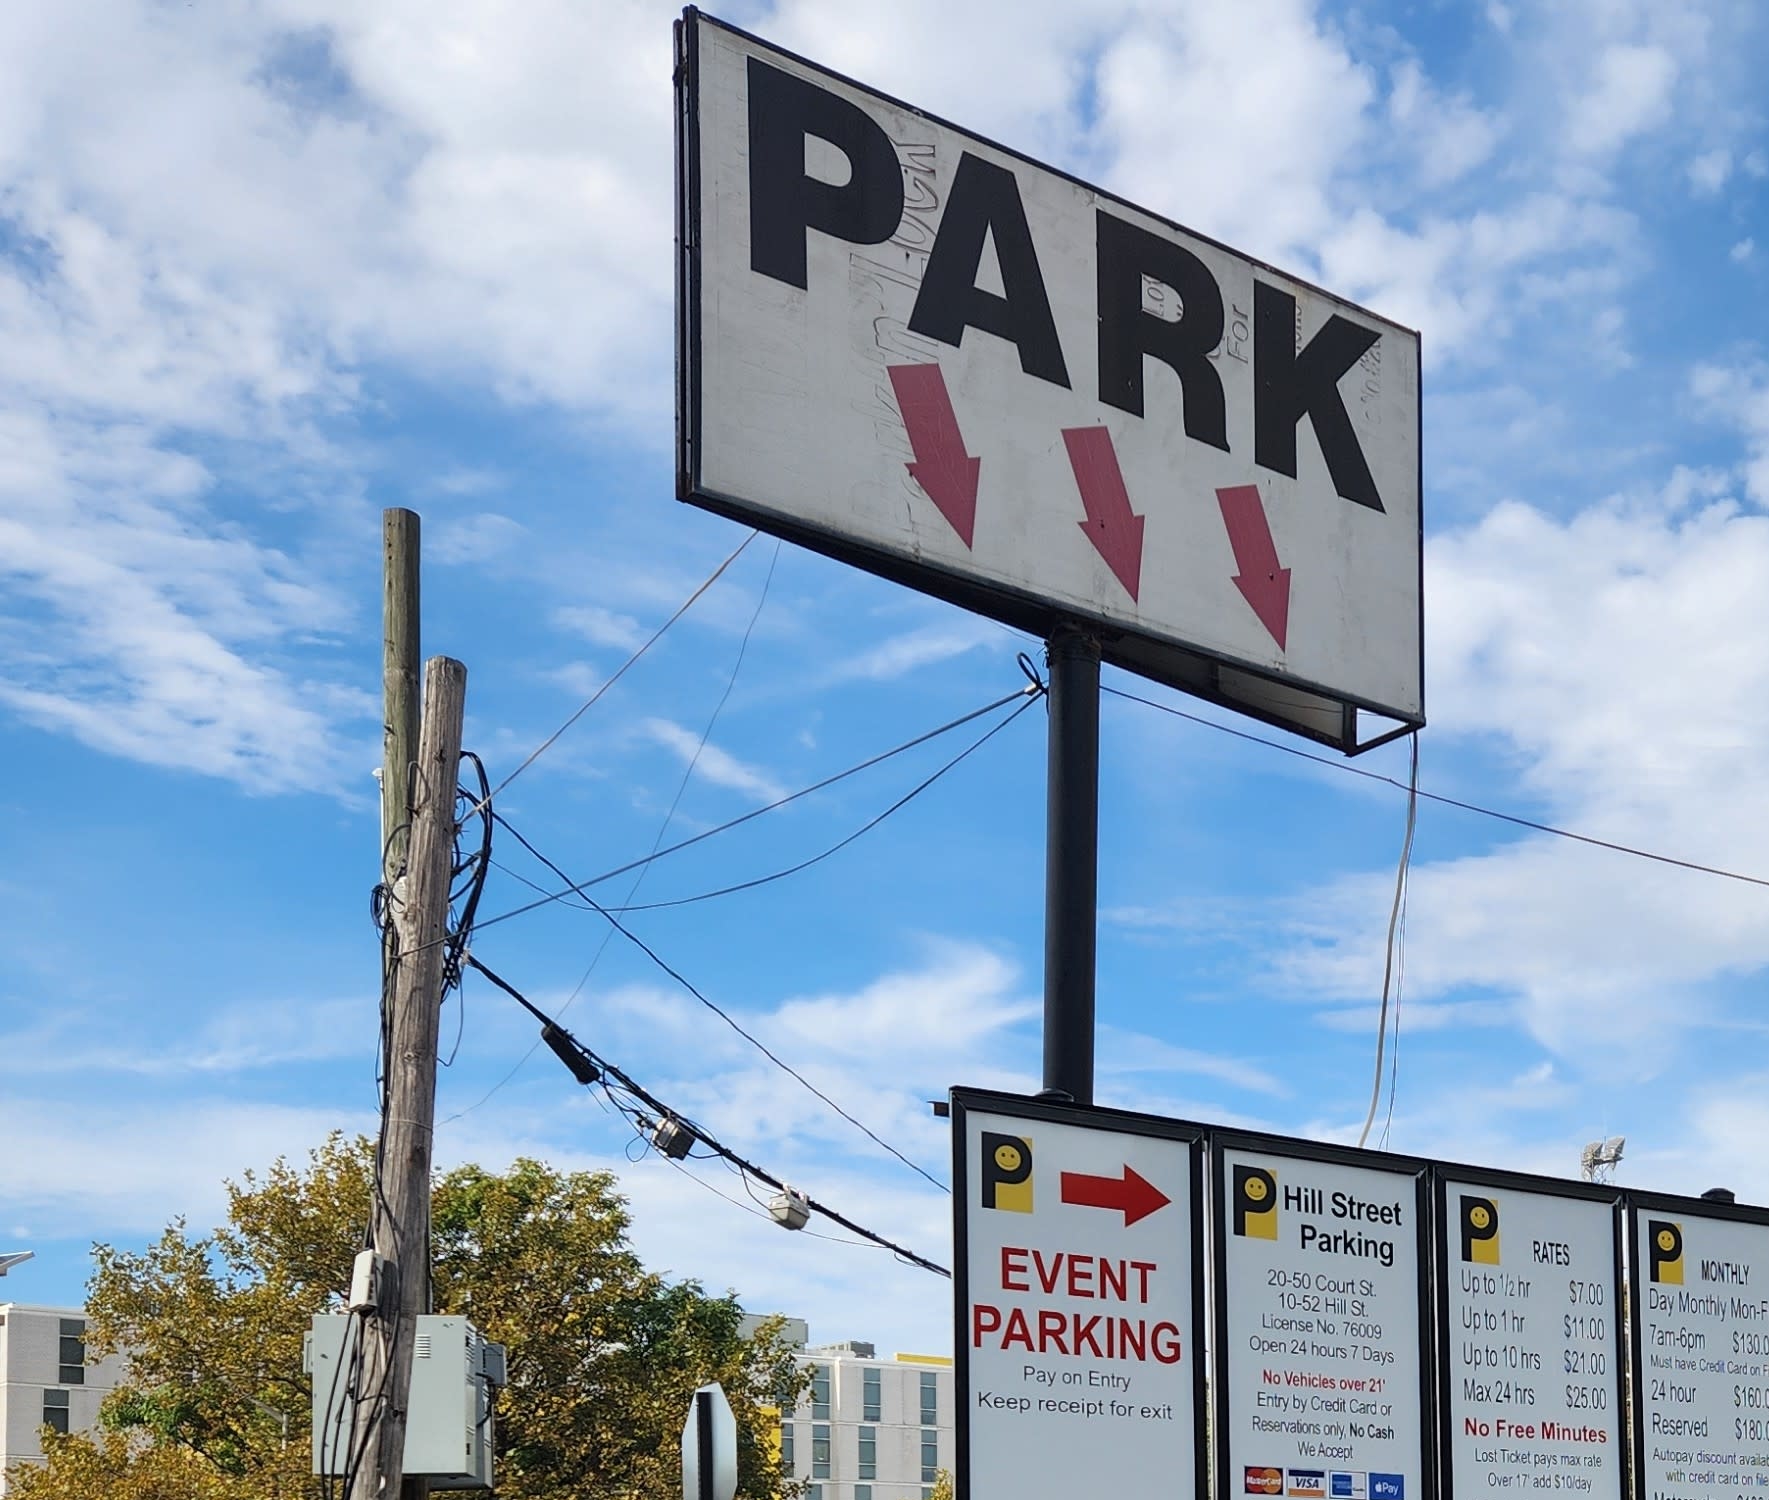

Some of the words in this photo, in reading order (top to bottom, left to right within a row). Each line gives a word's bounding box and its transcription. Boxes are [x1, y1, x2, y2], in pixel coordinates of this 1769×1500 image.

[747, 55, 1386, 515] PARK
[1284, 1185, 1323, 1215] Hill
[1331, 1192, 1402, 1226] Street
[1301, 1224, 1394, 1267] Parking
[1533, 1240, 1569, 1265] RATES
[1001, 1247, 1157, 1304] EVENT
[1267, 1269, 1311, 1289] 20-50
[1316, 1275, 1355, 1294] Court
[1360, 1280, 1376, 1296] St.
[1702, 1260, 1749, 1285] MONTHLY
[1462, 1269, 1479, 1298] Up
[1483, 1273, 1495, 1294] to
[1518, 1276, 1530, 1298] hr
[1569, 1280, 1603, 1305] $7.00
[1279, 1293, 1320, 1312] 10-52
[1326, 1297, 1346, 1315] Hill
[1351, 1301, 1368, 1317] St.
[1650, 1288, 1674, 1317] Day
[1679, 1291, 1726, 1322] Monthly
[973, 1304, 1181, 1364] PARKING
[1262, 1314, 1313, 1332] License
[1317, 1320, 1338, 1335] No.
[1343, 1322, 1382, 1339] 76009
[1462, 1306, 1480, 1334] Up
[1484, 1309, 1497, 1330] to
[1502, 1310, 1507, 1331] 1
[1512, 1310, 1525, 1332] hr
[1564, 1314, 1604, 1340] $11.00
[1650, 1324, 1705, 1351] 7am-6pm
[1250, 1336, 1286, 1355] Open
[1291, 1339, 1306, 1354] 24
[1312, 1340, 1347, 1359] hours
[1352, 1345, 1358, 1359] 7
[1363, 1346, 1394, 1366] Days
[1463, 1342, 1481, 1370] Up
[1485, 1346, 1498, 1367] to
[1503, 1346, 1517, 1368] 10
[1521, 1347, 1541, 1370] hrs
[1564, 1350, 1605, 1375] $21.00
[1651, 1354, 1672, 1368] Must
[1675, 1357, 1696, 1370] have
[1700, 1358, 1725, 1373] Credit
[1727, 1361, 1747, 1375] Card
[1750, 1365, 1760, 1375] on
[1024, 1365, 1056, 1387] Pay
[1062, 1373, 1082, 1385] on
[1089, 1371, 1131, 1392] Entry
[1264, 1370, 1280, 1384] No
[1284, 1371, 1335, 1388] Vehicles
[1340, 1381, 1366, 1391] over
[1369, 1379, 1385, 1392] 21'
[1651, 1379, 1665, 1401] 24
[1670, 1380, 1696, 1403] hour
[978, 1392, 1031, 1412] Keep
[1038, 1398, 1104, 1417] receipt
[1110, 1401, 1134, 1416] for
[1141, 1404, 1172, 1419] exit
[1257, 1392, 1289, 1412] Entry
[1293, 1395, 1307, 1413] by
[1311, 1396, 1346, 1412] Credit
[1350, 1399, 1377, 1415] Card
[1381, 1404, 1392, 1416] or
[1464, 1378, 1491, 1402] Max
[1496, 1381, 1510, 1403] 24
[1515, 1382, 1534, 1405] hrs
[1566, 1385, 1607, 1410] $25.00
[1253, 1416, 1320, 1435] Reservations
[1350, 1423, 1364, 1437] No
[1368, 1426, 1394, 1439] Cash
[1465, 1418, 1489, 1436] No
[1497, 1420, 1534, 1438] Free
[1542, 1421, 1607, 1443] Minutes
[1653, 1412, 1708, 1437] Reserved
[1298, 1442, 1315, 1456] We
[1319, 1443, 1353, 1461] Accept
[1475, 1448, 1497, 1463] Lost
[1500, 1449, 1530, 1464] Ticket
[1534, 1455, 1557, 1468] pays
[1561, 1456, 1580, 1466] max
[1584, 1454, 1602, 1467] rate
[1653, 1448, 1693, 1465] Autopay
[1697, 1450, 1736, 1465] discount
[1296, 1478, 1319, 1488] VISA
[1381, 1483, 1398, 1495] Pay
[1488, 1473, 1512, 1487] Over
[1533, 1475, 1551, 1488] add
[1555, 1475, 1592, 1493] $10/day
[1666, 1469, 1685, 1482] with
[1689, 1472, 1715, 1484] credit
[1718, 1472, 1738, 1485] card
[1742, 1477, 1752, 1485] on
[1756, 1473, 1768, 1486] file
